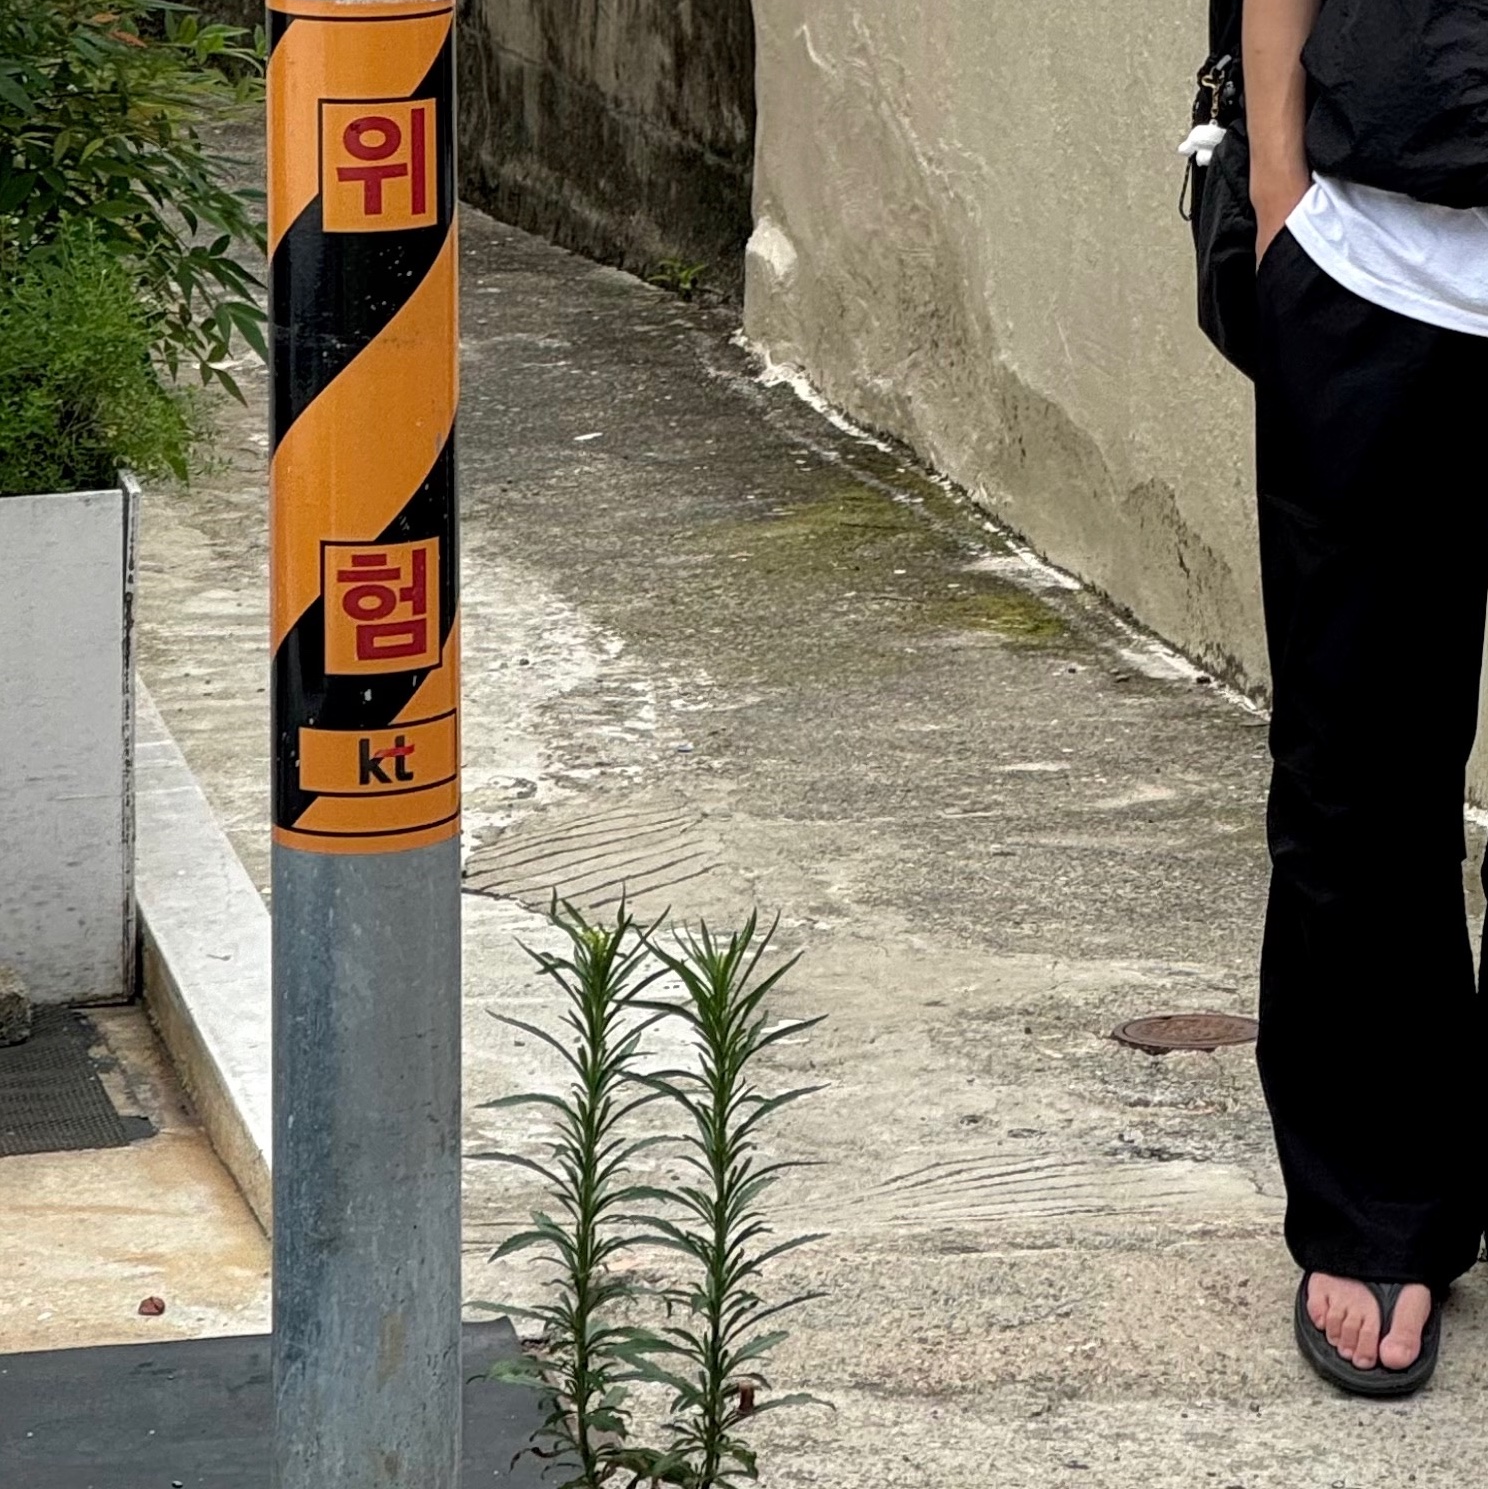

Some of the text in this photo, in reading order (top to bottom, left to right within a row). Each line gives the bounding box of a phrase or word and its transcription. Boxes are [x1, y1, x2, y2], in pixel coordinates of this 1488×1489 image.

[335, 107, 426, 216] 위
[336, 548, 427, 661] 험
[358, 734, 415, 786] kt
